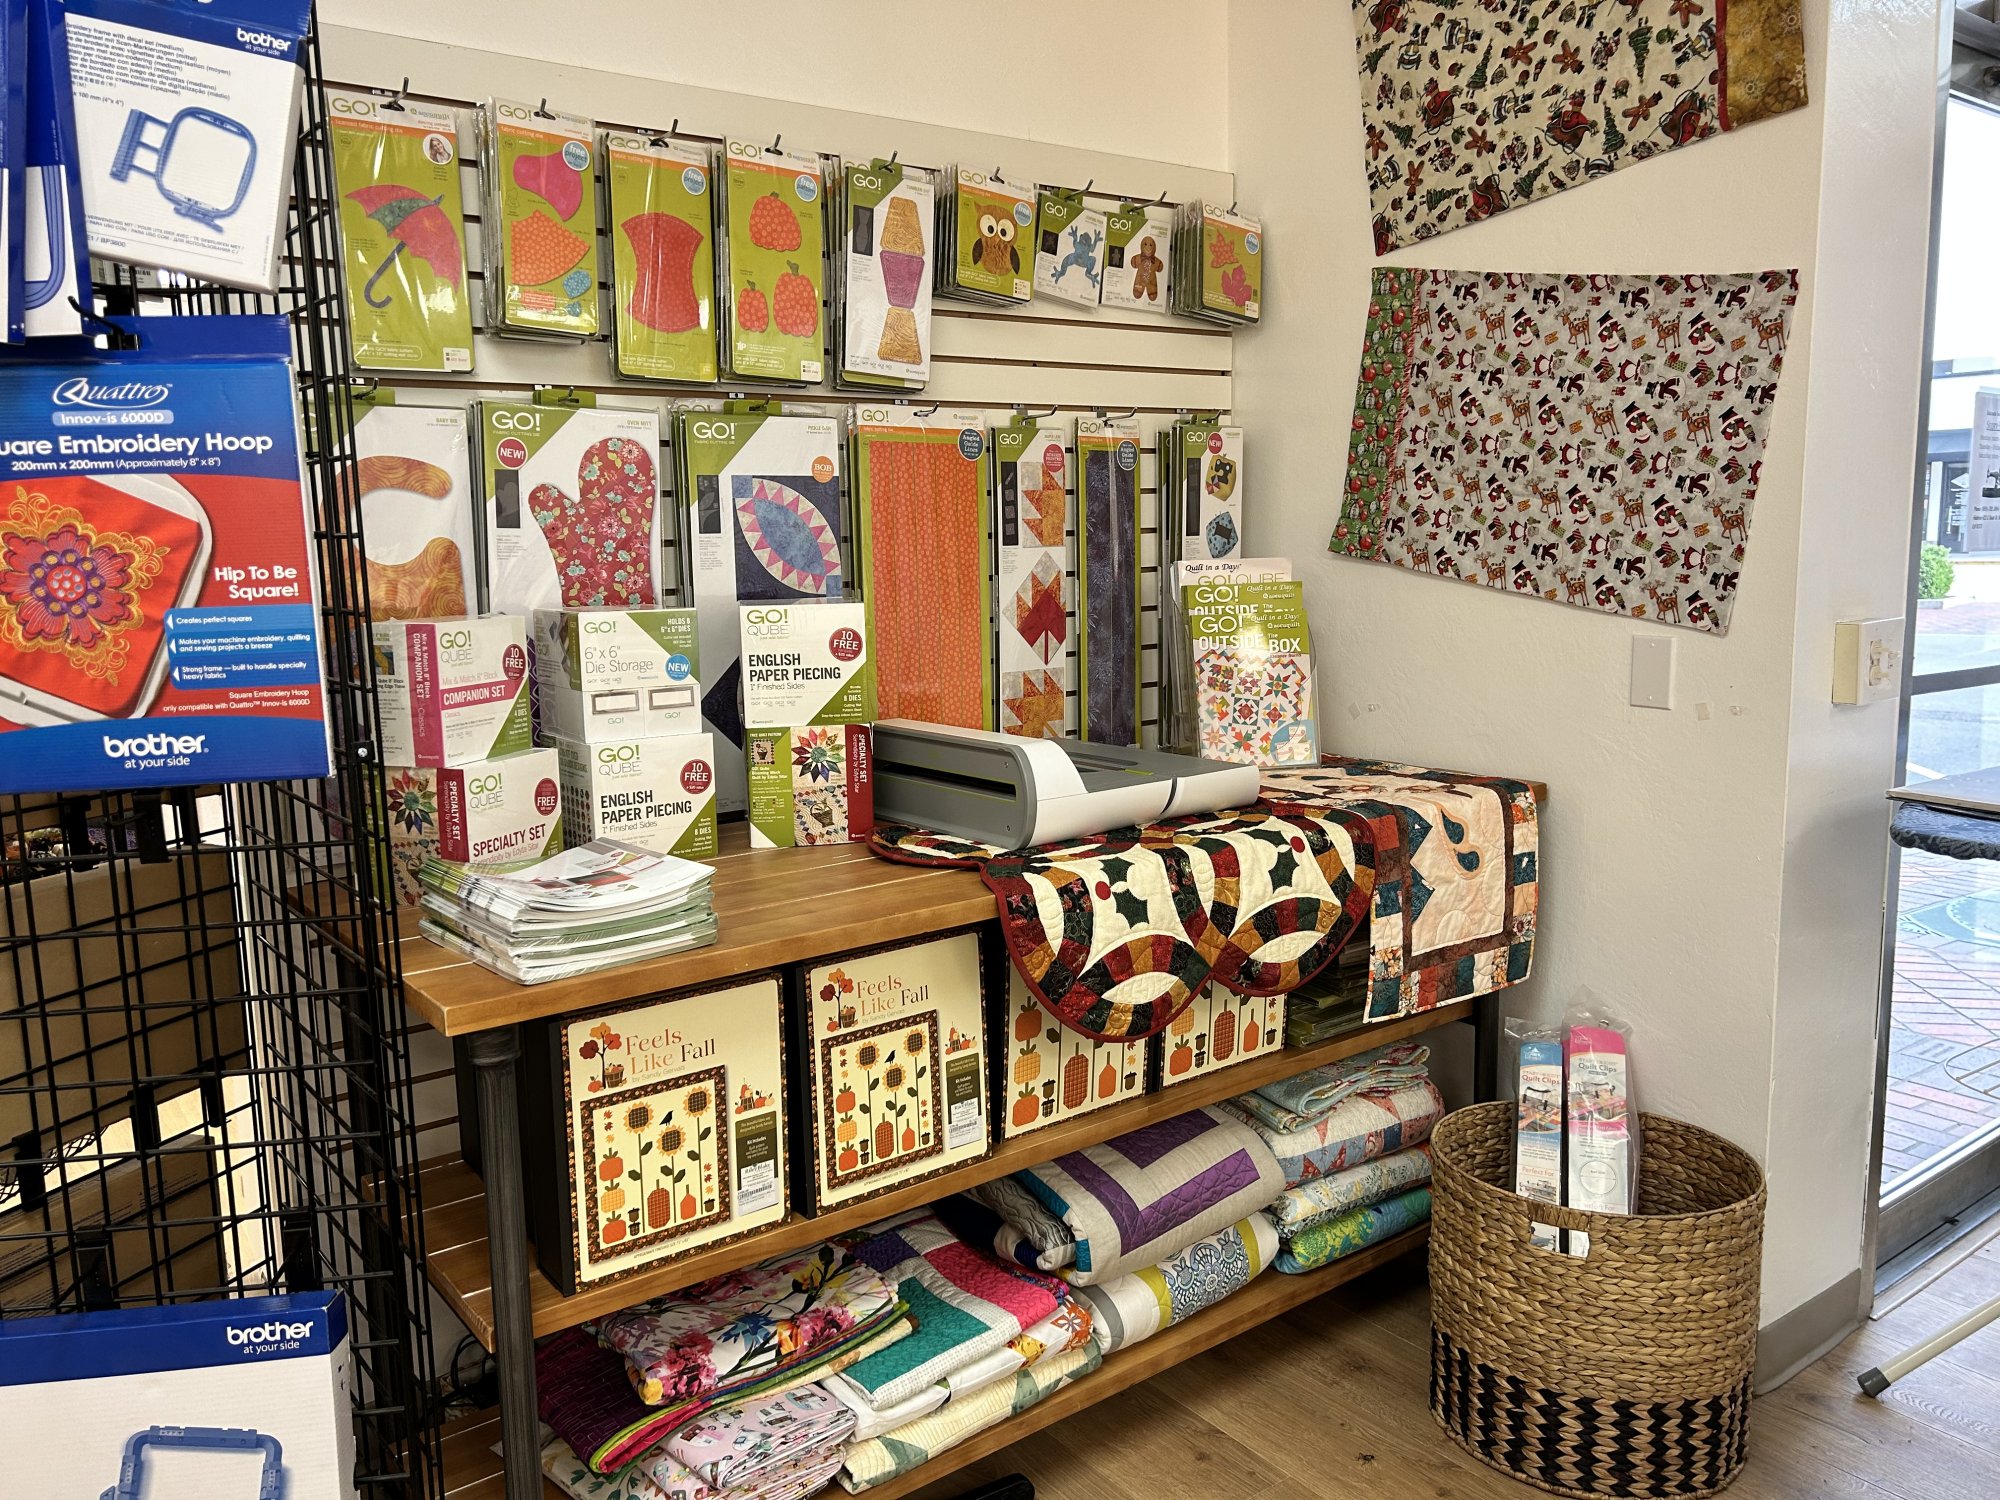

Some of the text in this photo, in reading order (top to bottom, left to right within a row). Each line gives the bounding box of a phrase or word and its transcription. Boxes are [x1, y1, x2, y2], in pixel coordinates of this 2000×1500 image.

[112, 31, 125, 40] with
[236, 27, 291, 52] brother
[254, 45, 267, 55] your
[267, 46, 281, 56] side
[332, 97, 378, 118] GO!
[499, 104, 532, 122] GO!
[569, 143, 586, 156] free
[729, 141, 762, 160] GO!
[853, 173, 882, 191] GO!
[1044, 201, 1067, 219] GO!
[1109, 217, 1132, 232] GO!
[120, 411, 164, 424] 6000D
[491, 410, 541, 432] GO!
[861, 409, 889, 423] GO!
[693, 421, 735, 440] GO!
[1186, 431, 1207, 443] GO!
[58, 433, 200, 456] Embroidery
[205, 432, 273, 455] Hoop
[999, 433, 1023, 446] GO!
[500, 447, 525, 460] NEW!
[11, 461, 57, 471] 200mm
[60, 462, 67, 470] x
[69, 459, 115, 470] 200mm
[115, 457, 189, 470] (Approximately
[814, 463, 832, 472] BOB
[214, 565, 298, 584] Hip To Be
[1185, 563, 1203, 574] Quilt
[1205, 563, 1213, 571] in
[228, 582, 299, 601] Square!
[1195, 585, 1240, 603] GO!
[203, 616, 226, 625] perfect
[227, 615, 252, 624] squares
[746, 608, 789, 625] GO!
[1199, 615, 1244, 633] GO!
[584, 620, 617, 634] GO!
[746, 624, 790, 637] QUBE
[202, 637, 216, 646] your
[217, 635, 246, 643] machine
[286, 633, 311, 643] quilting
[440, 630, 473, 650] GO!
[841, 630, 854, 641] 10
[1198, 633, 1265, 651] OUTSIDE
[179, 644, 193, 652] and
[194, 643, 216, 653] sewing
[217, 642, 244, 652] projects
[250, 641, 273, 649] breeze
[510, 647, 519, 658] 10
[584, 645, 621, 660] 6" x 6"
[833, 639, 860, 651] FREE
[1268, 638, 1302, 653] BOX
[441, 648, 473, 664] QUBE
[505, 658, 524, 669] FREE
[748, 653, 801, 667] ENGLISH
[182, 665, 203, 674] Strong
[203, 664, 223, 672] frame
[254, 662, 277, 670] handle
[413, 633, 425, 699] COMPANION SET
[585, 659, 655, 675] Die Storage
[667, 663, 689, 673] NEW
[183, 671, 226, 681] heavy fabrics
[749, 666, 842, 682] PAPER PIECING
[757, 682, 786, 690] Finished
[786, 682, 806, 690] Sides
[229, 688, 310, 700] Square Embroidery Hoop
[443, 685, 506, 706] COMPANION SET
[848, 694, 862, 702] DIES
[163, 704, 177, 713] only
[178, 702, 214, 712] compatible
[214, 701, 228, 710] with
[288, 698, 311, 707] 6000D
[607, 716, 625, 725] GO!
[664, 711, 681, 719] GO!
[103, 733, 206, 760] brother
[598, 744, 640, 764] GO!
[124, 754, 190, 771] at your side
[858, 733, 868, 783] SPECIALTY SET
[598, 761, 642, 777] QUBE
[692, 762, 703, 772] 10
[468, 773, 503, 796] GO!
[684, 772, 709, 783] FREE
[469, 791, 504, 809] QUBE
[536, 795, 556, 807] FREE
[600, 790, 654, 809] ENGLISH
[449, 781, 461, 841] SPECIALTY SET
[602, 800, 692, 825] PAPER PIECING
[609, 822, 638, 834] Finished
[639, 820, 658, 829] Sides
[699, 826, 712, 836] DIES
[473, 823, 546, 858] SPECIALTY SET
[856, 974, 902, 999] Feels
[861, 984, 930, 1017] Like Fall
[626, 1028, 682, 1056] Feels
[631, 1038, 716, 1075] Like Fall
[1578, 1062, 1617, 1073] Quilt Clips
[632, 1075, 641, 1084] by
[641, 1070, 662, 1081] Sandy
[1521, 1074, 1560, 1086] Quilt Clips
[226, 1320, 313, 1345] brother
[243, 1340, 300, 1356] at your side
